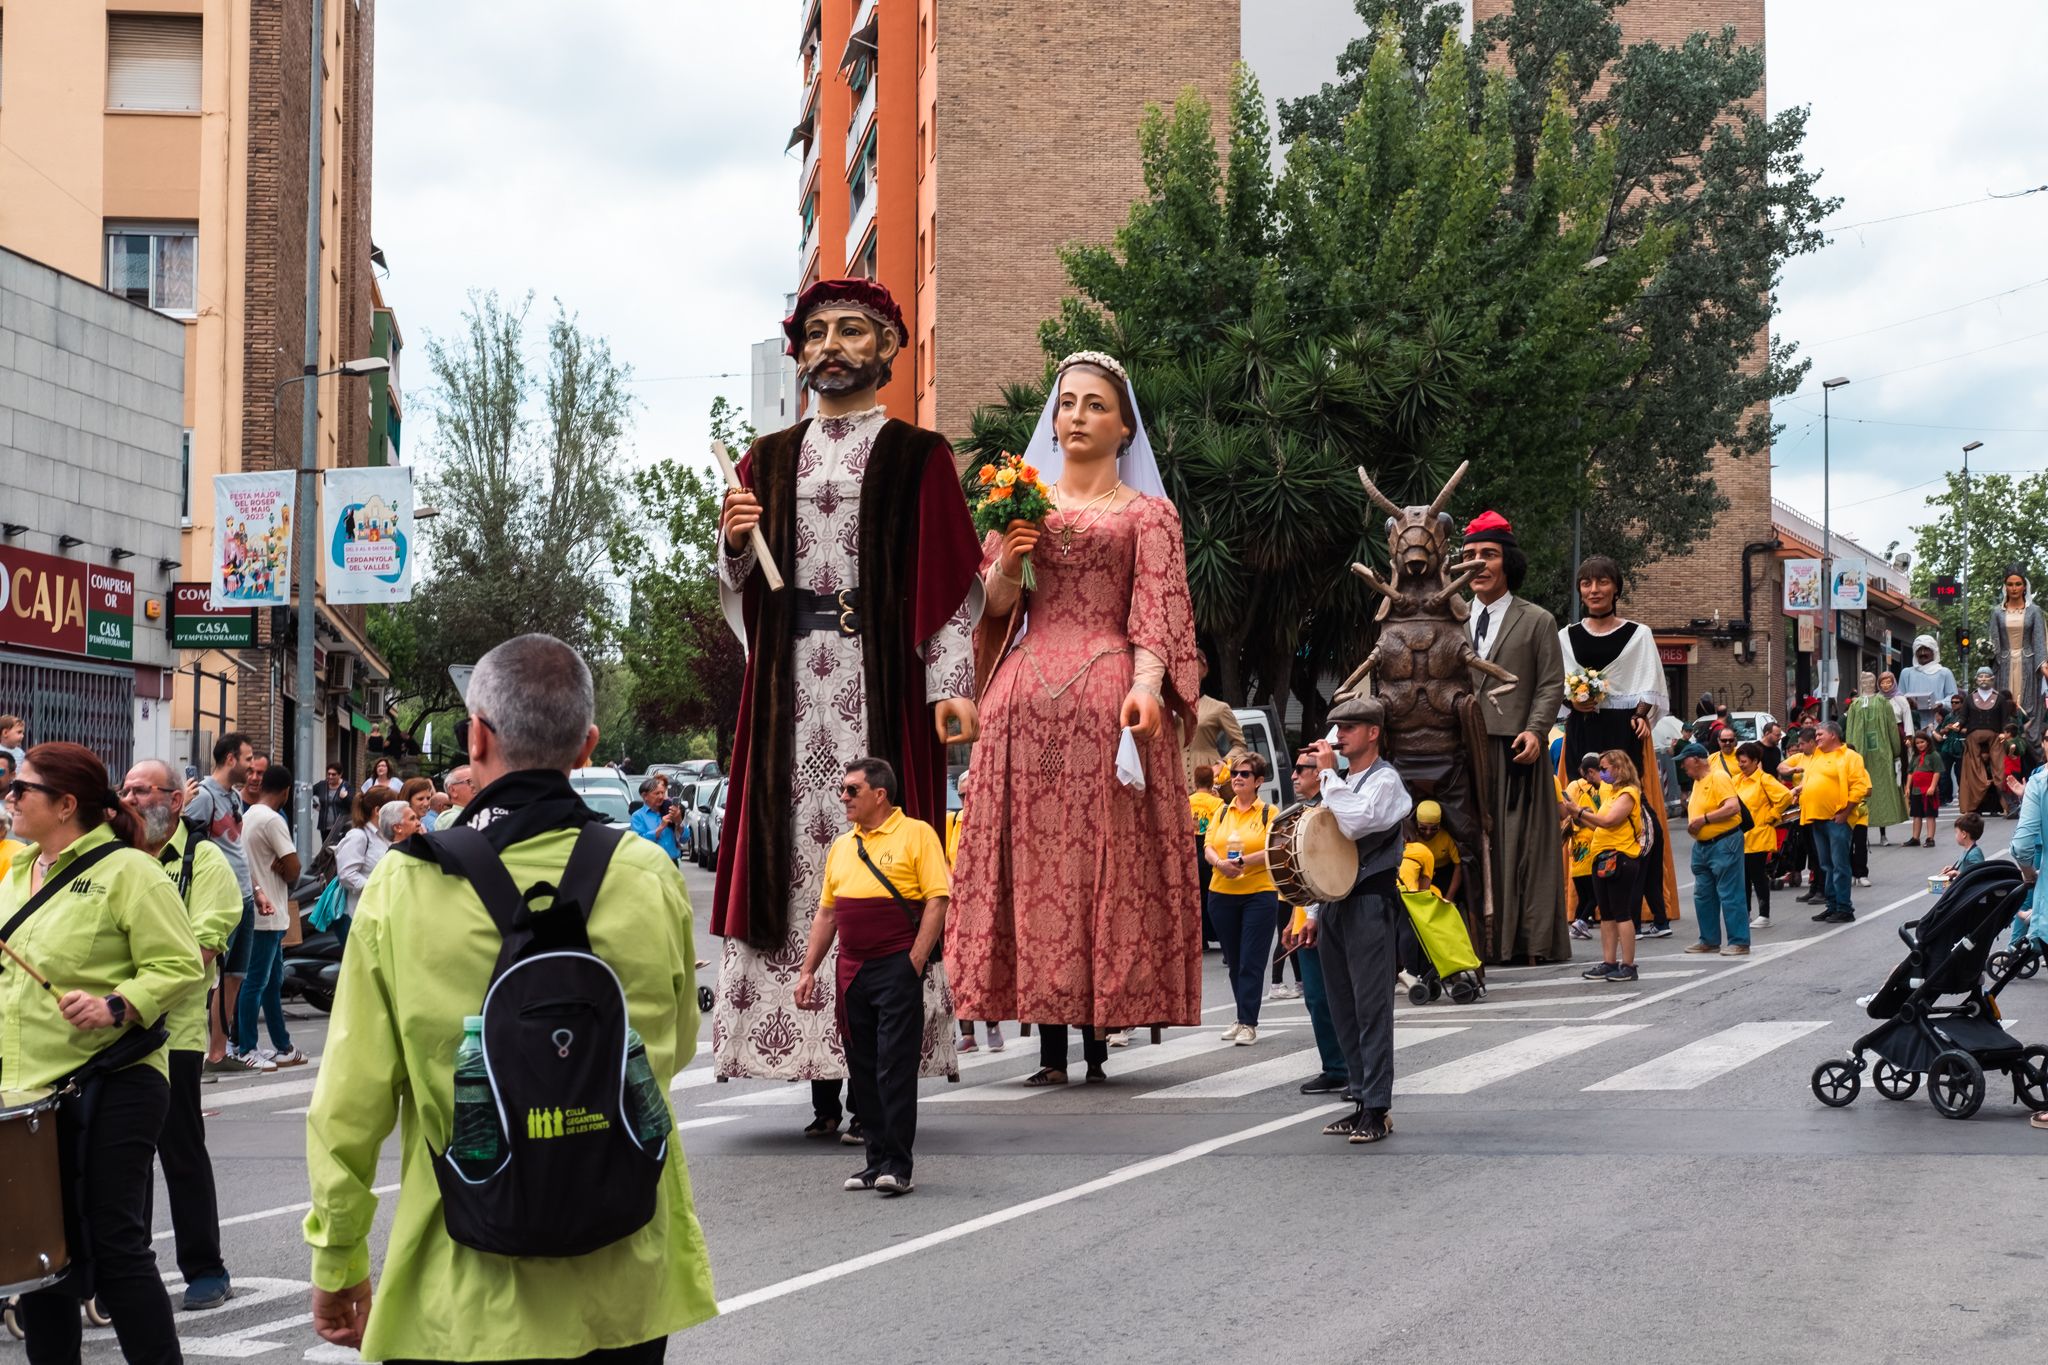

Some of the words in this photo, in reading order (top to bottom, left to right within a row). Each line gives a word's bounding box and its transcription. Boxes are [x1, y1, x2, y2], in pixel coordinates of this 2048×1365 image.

[254, 491, 280, 499] MAJOR
[91, 574, 131, 595] COMPREM
[105, 593, 117, 608] OR
[100, 621, 120, 638] CASA
[196, 622, 229, 633] CASA
[565, 1107, 586, 1117] COLLA
[566, 1113, 604, 1126] GEGANTERA
[566, 1126, 575, 1135] DE
[576, 1124, 588, 1133] LES
[589, 1121, 610, 1131] FONTS
